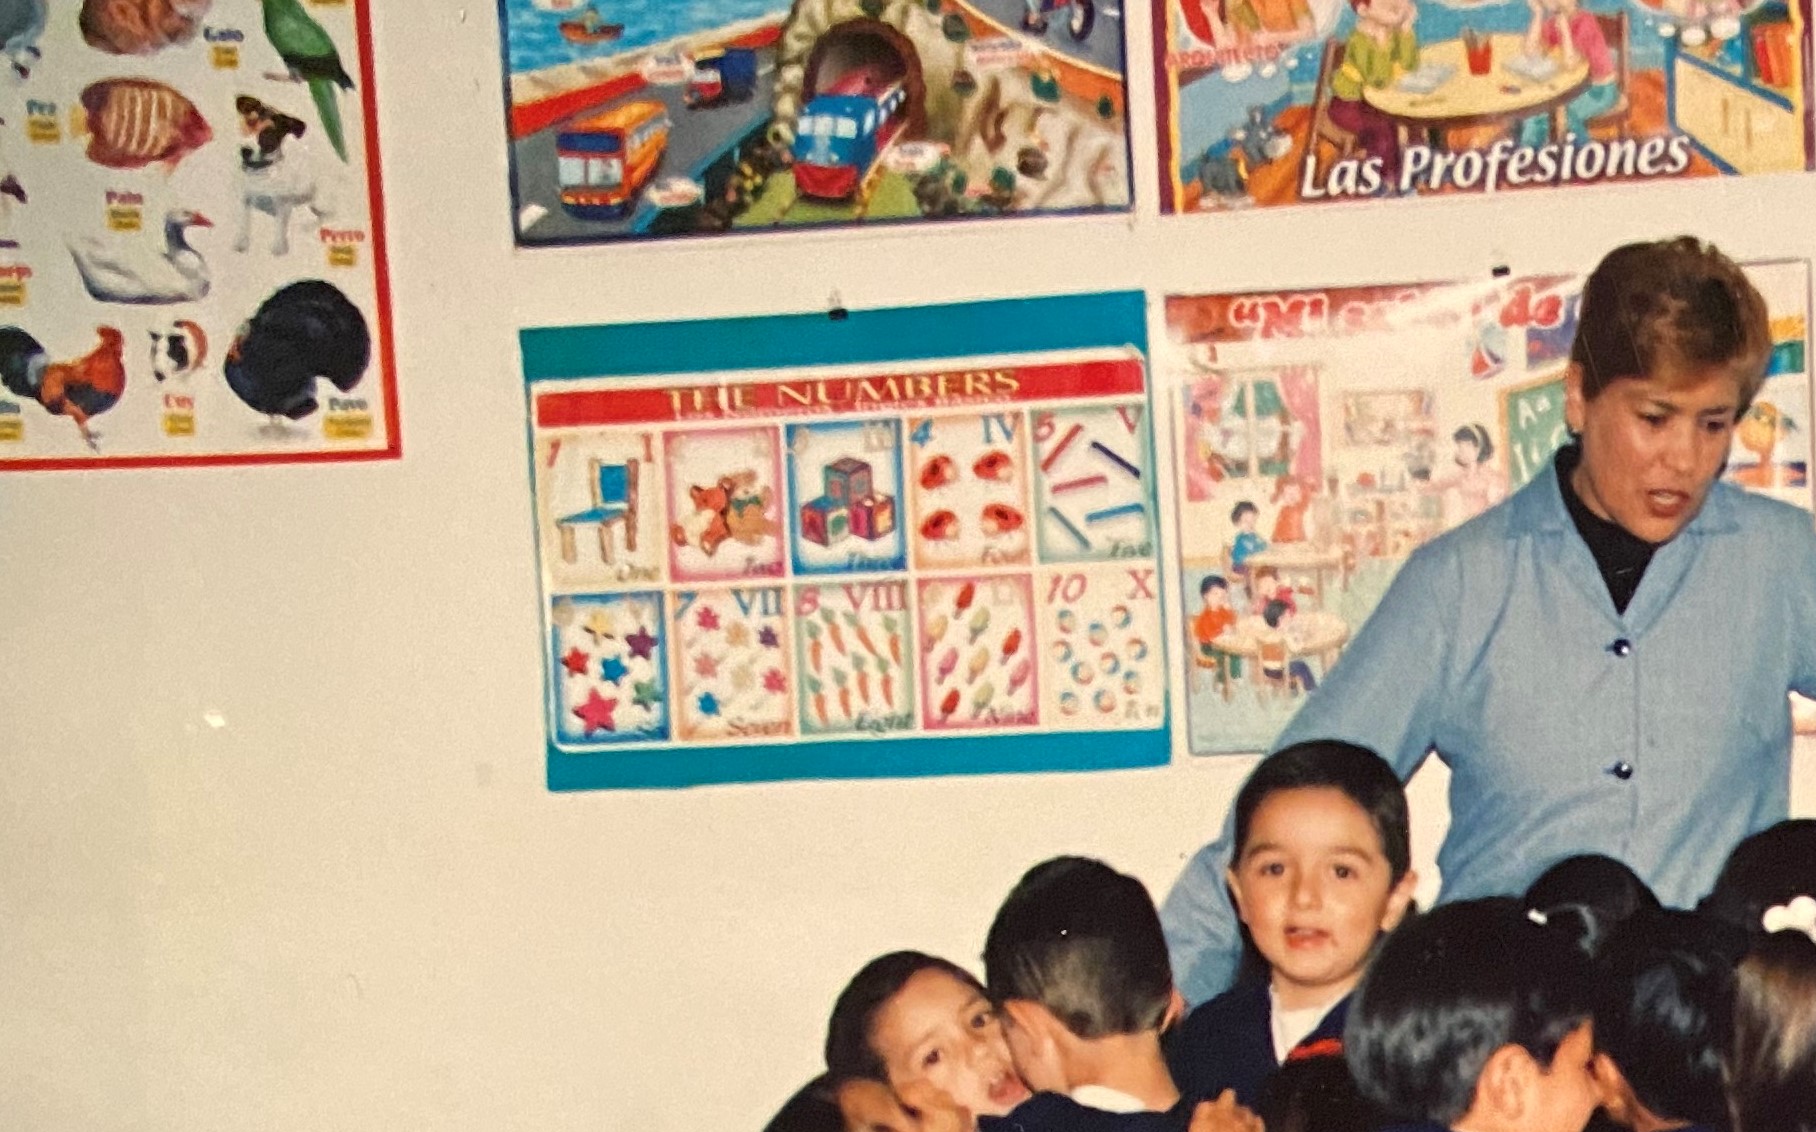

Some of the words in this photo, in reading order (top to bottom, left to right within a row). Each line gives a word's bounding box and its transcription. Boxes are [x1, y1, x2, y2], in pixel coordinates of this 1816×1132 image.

[1302, 153, 1384, 198] Las
[1399, 133, 1690, 193] Profesiones
[777, 370, 1021, 406] NUMBERS
[909, 418, 933, 448] 4
[980, 412, 1023, 444] IV
[1115, 404, 1145, 434] V
[841, 582, 907, 612] VIII
[1047, 573, 1087, 604] 10
[1126, 569, 1154, 600] X
[674, 591, 698, 619] 7
[730, 588, 783, 616] VII
